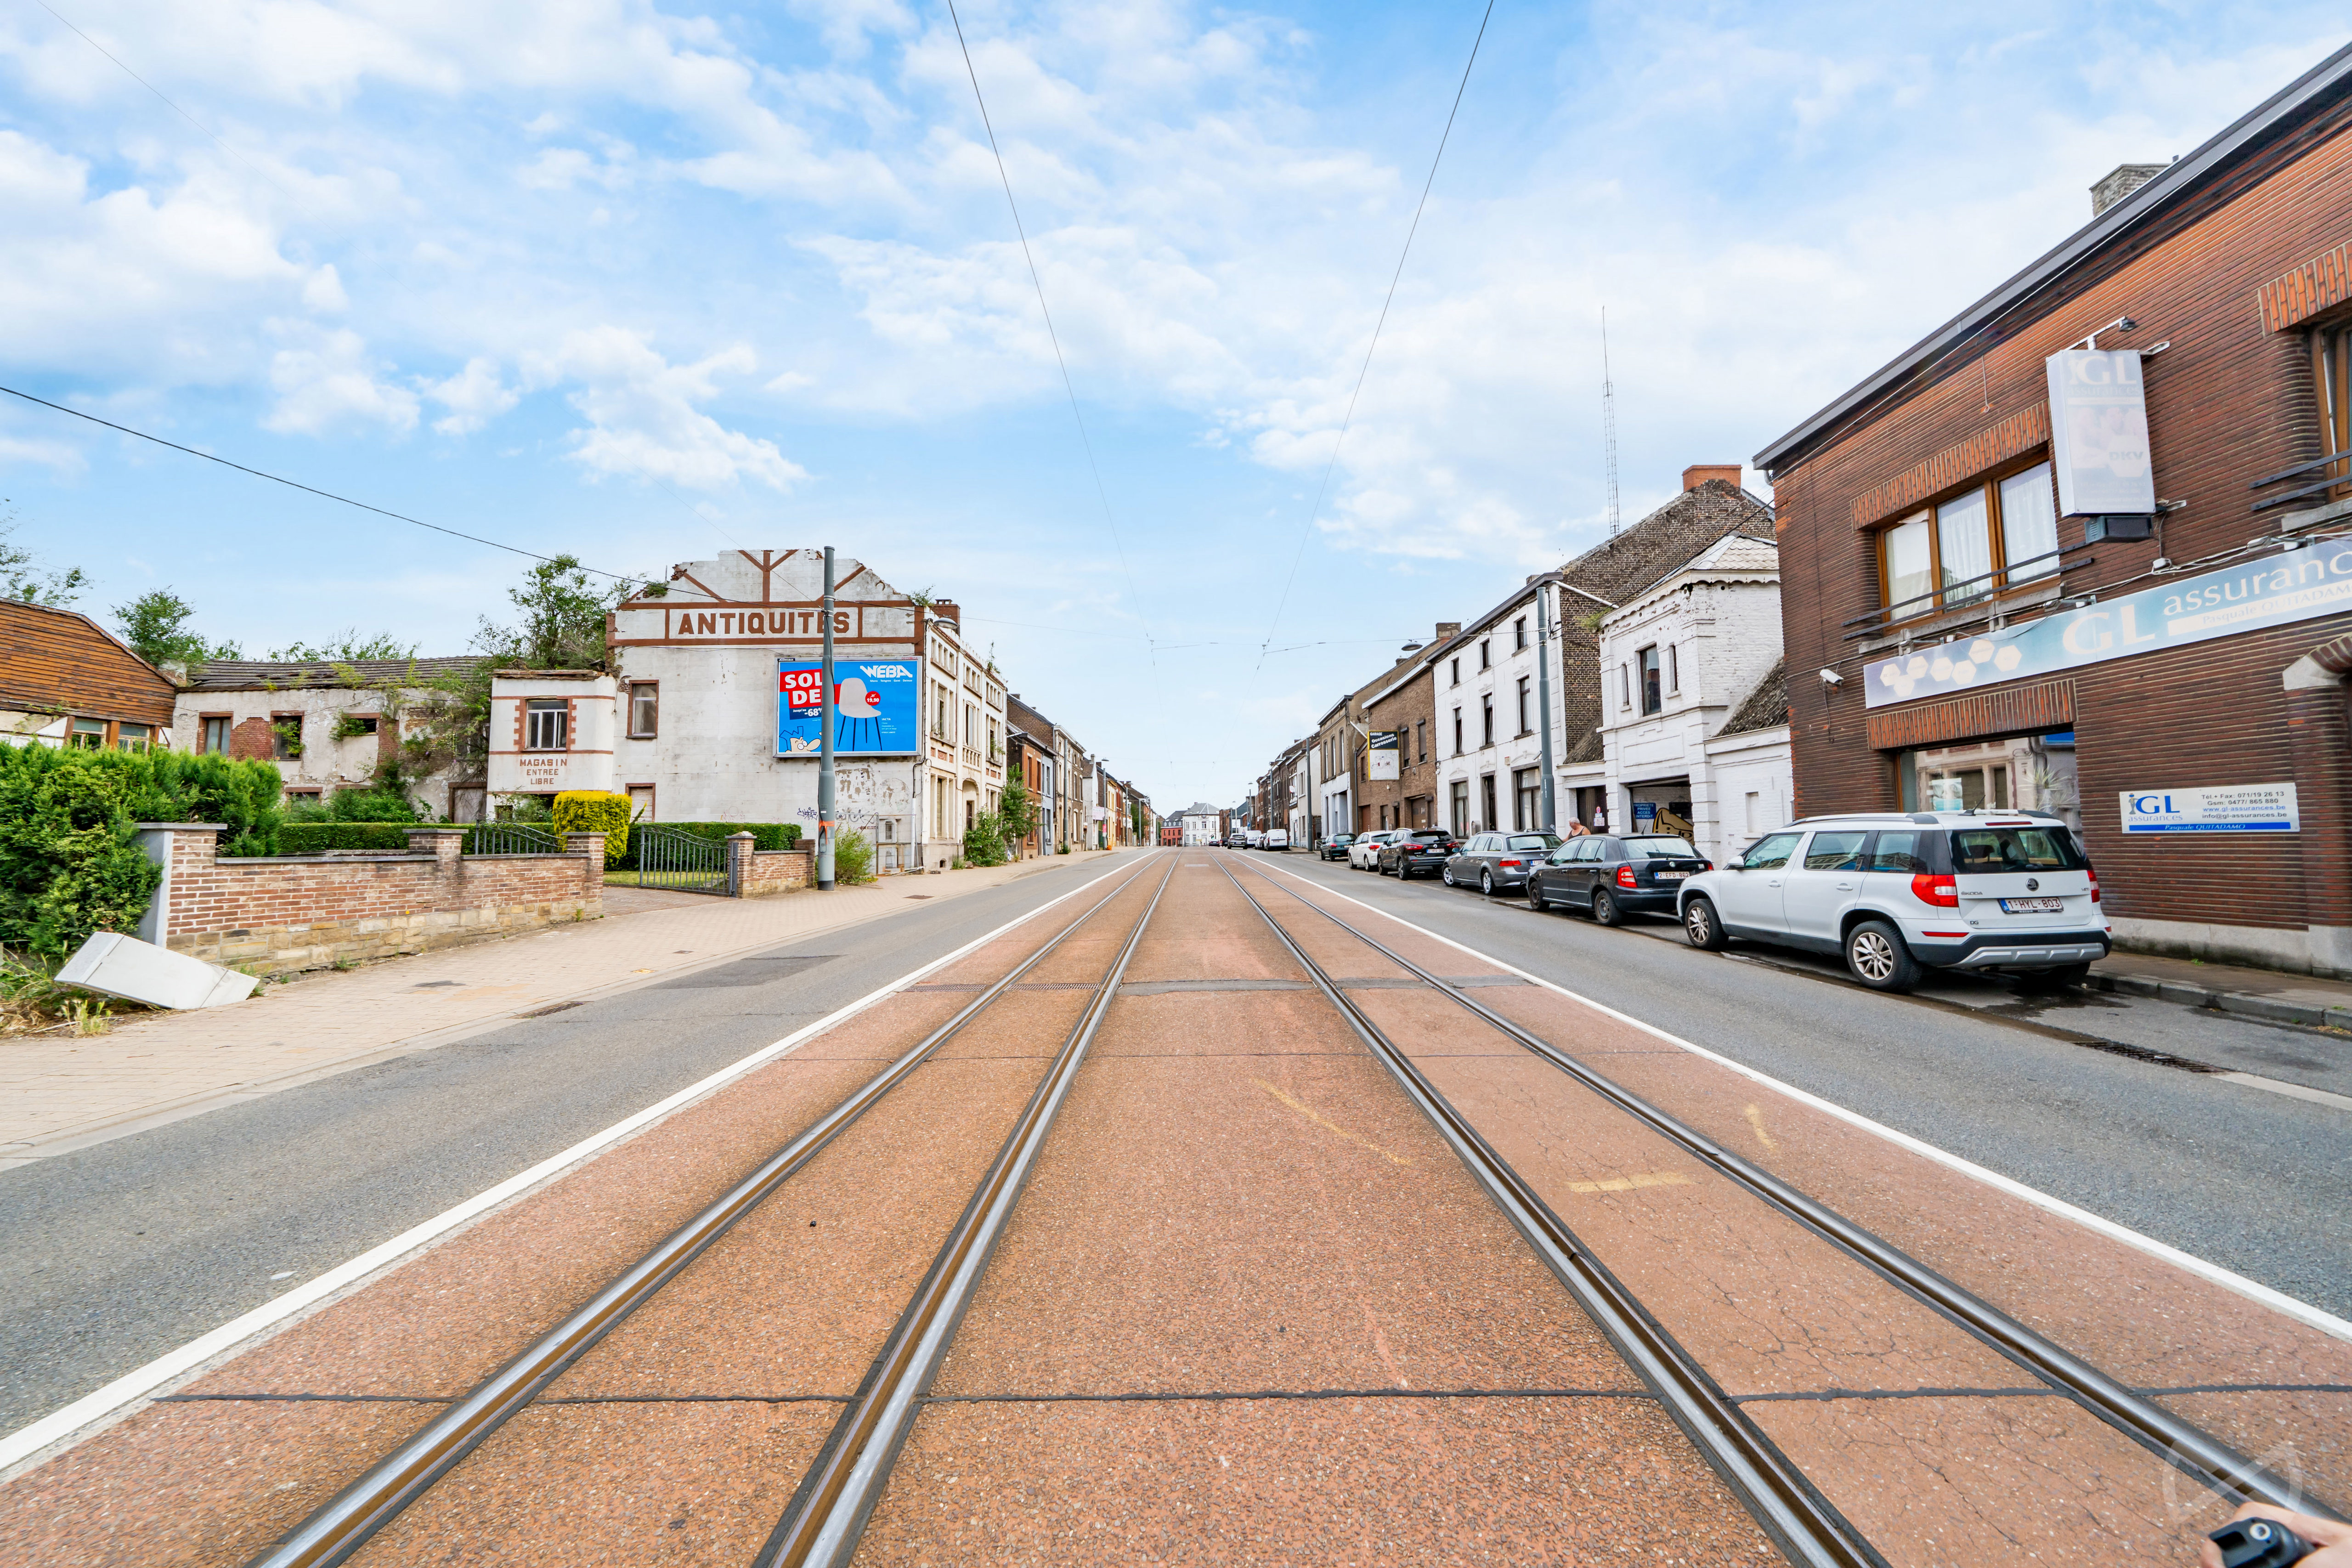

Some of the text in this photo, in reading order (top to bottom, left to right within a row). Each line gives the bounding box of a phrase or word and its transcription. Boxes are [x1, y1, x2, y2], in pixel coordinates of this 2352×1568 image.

[2109, 451, 2143, 460] DKV
[2203, 606, 2256, 625] Pasquale
[2062, 604, 2155, 655] GL
[860, 665, 913, 678] WEBA
[1371, 737, 1397, 748] Carrosserie
[1372, 734, 1394, 743] Occasions
[2008, 899, 2060, 909] 1-HYL-803
